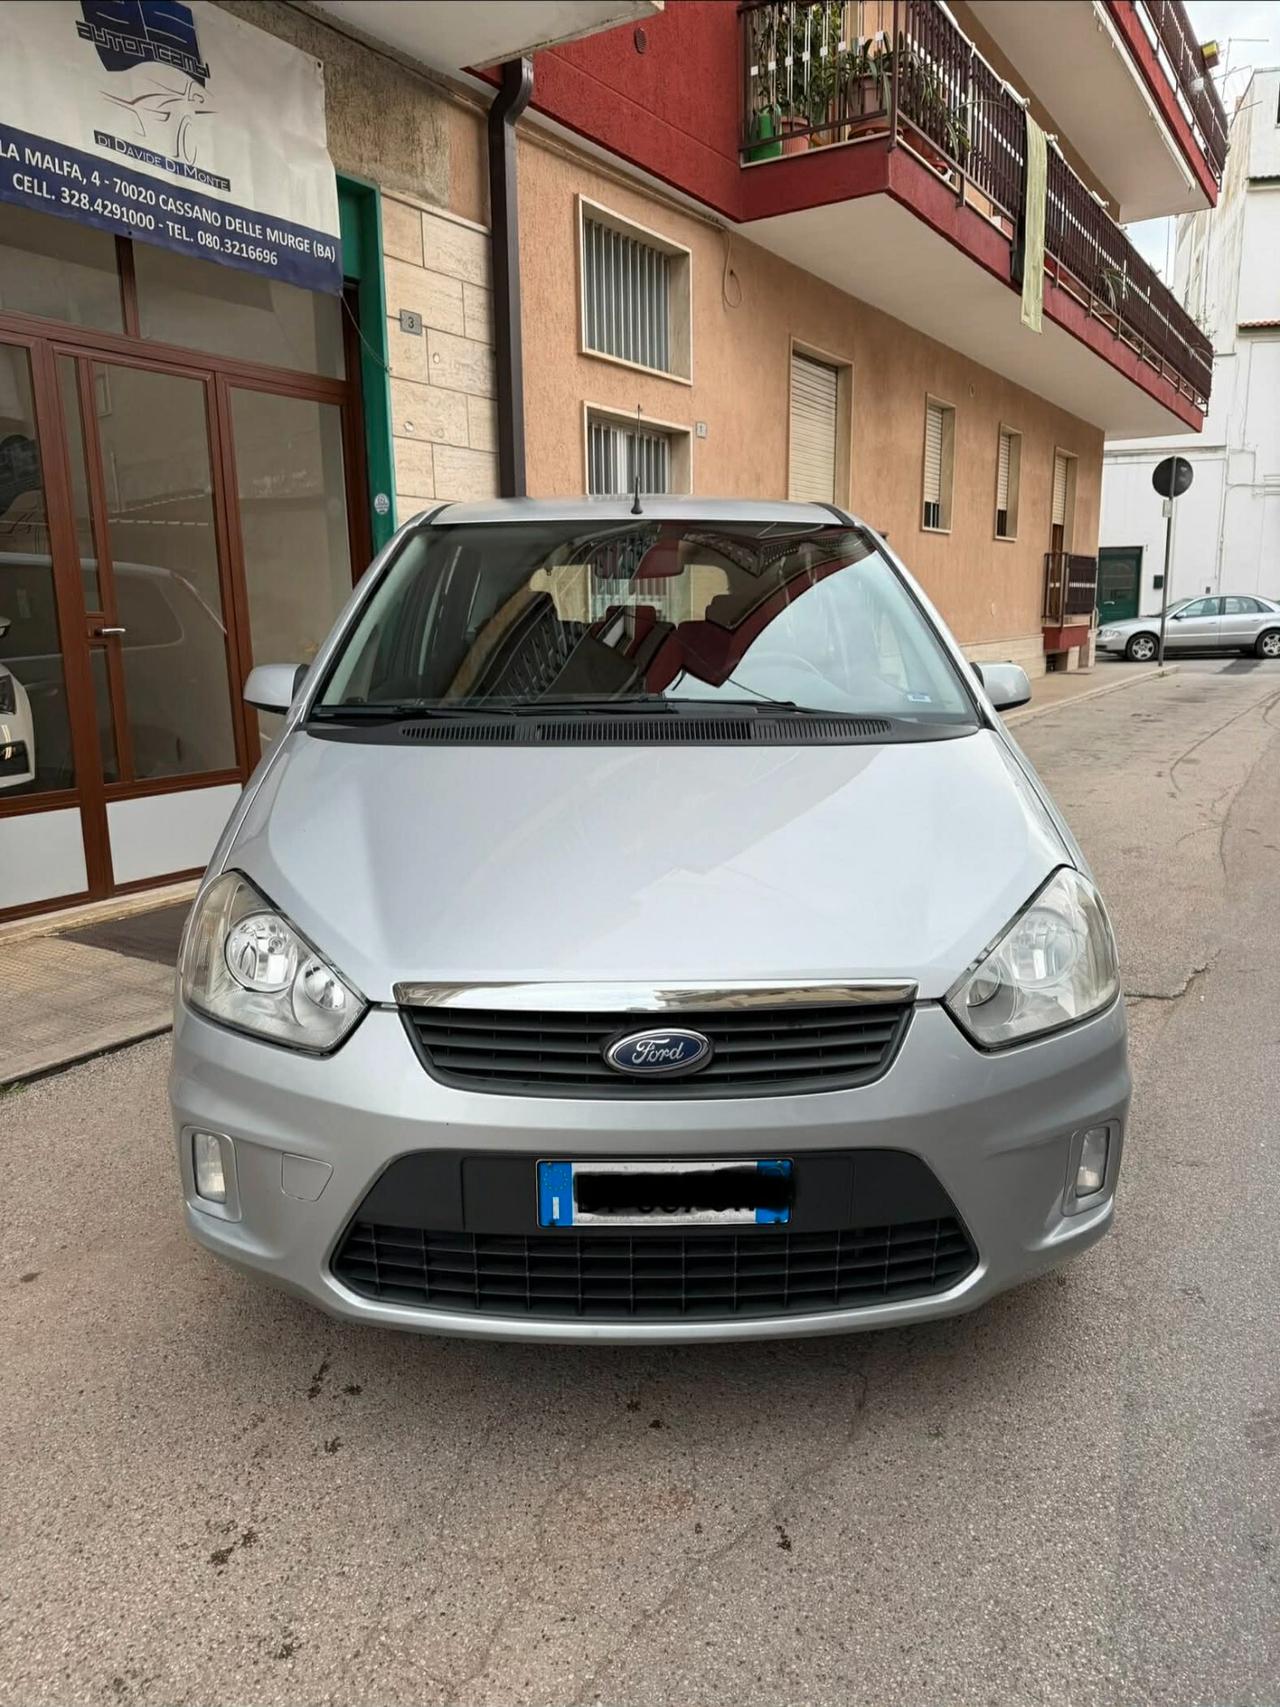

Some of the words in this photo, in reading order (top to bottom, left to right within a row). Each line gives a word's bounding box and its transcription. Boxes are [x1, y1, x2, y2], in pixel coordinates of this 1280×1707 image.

[0, 139, 20, 161] LA
[25, 147, 87, 185] MALFA,
[91, 170, 101, 187] 4
[113, 178, 156, 205] 70020
[159, 194, 221, 227] CASSANO
[225, 216, 263, 239] DELLE
[266, 227, 311, 253] MURGE
[313, 240, 336, 263] (BA)
[12, 173, 56, 200] CELL.
[60, 187, 155, 231] 328.4291000
[166, 221, 194, 242] TEL.
[197, 228, 278, 266] 080.3216696
[407, 316, 415, 329] 3
[632, 1038, 685, 1064] Ford
